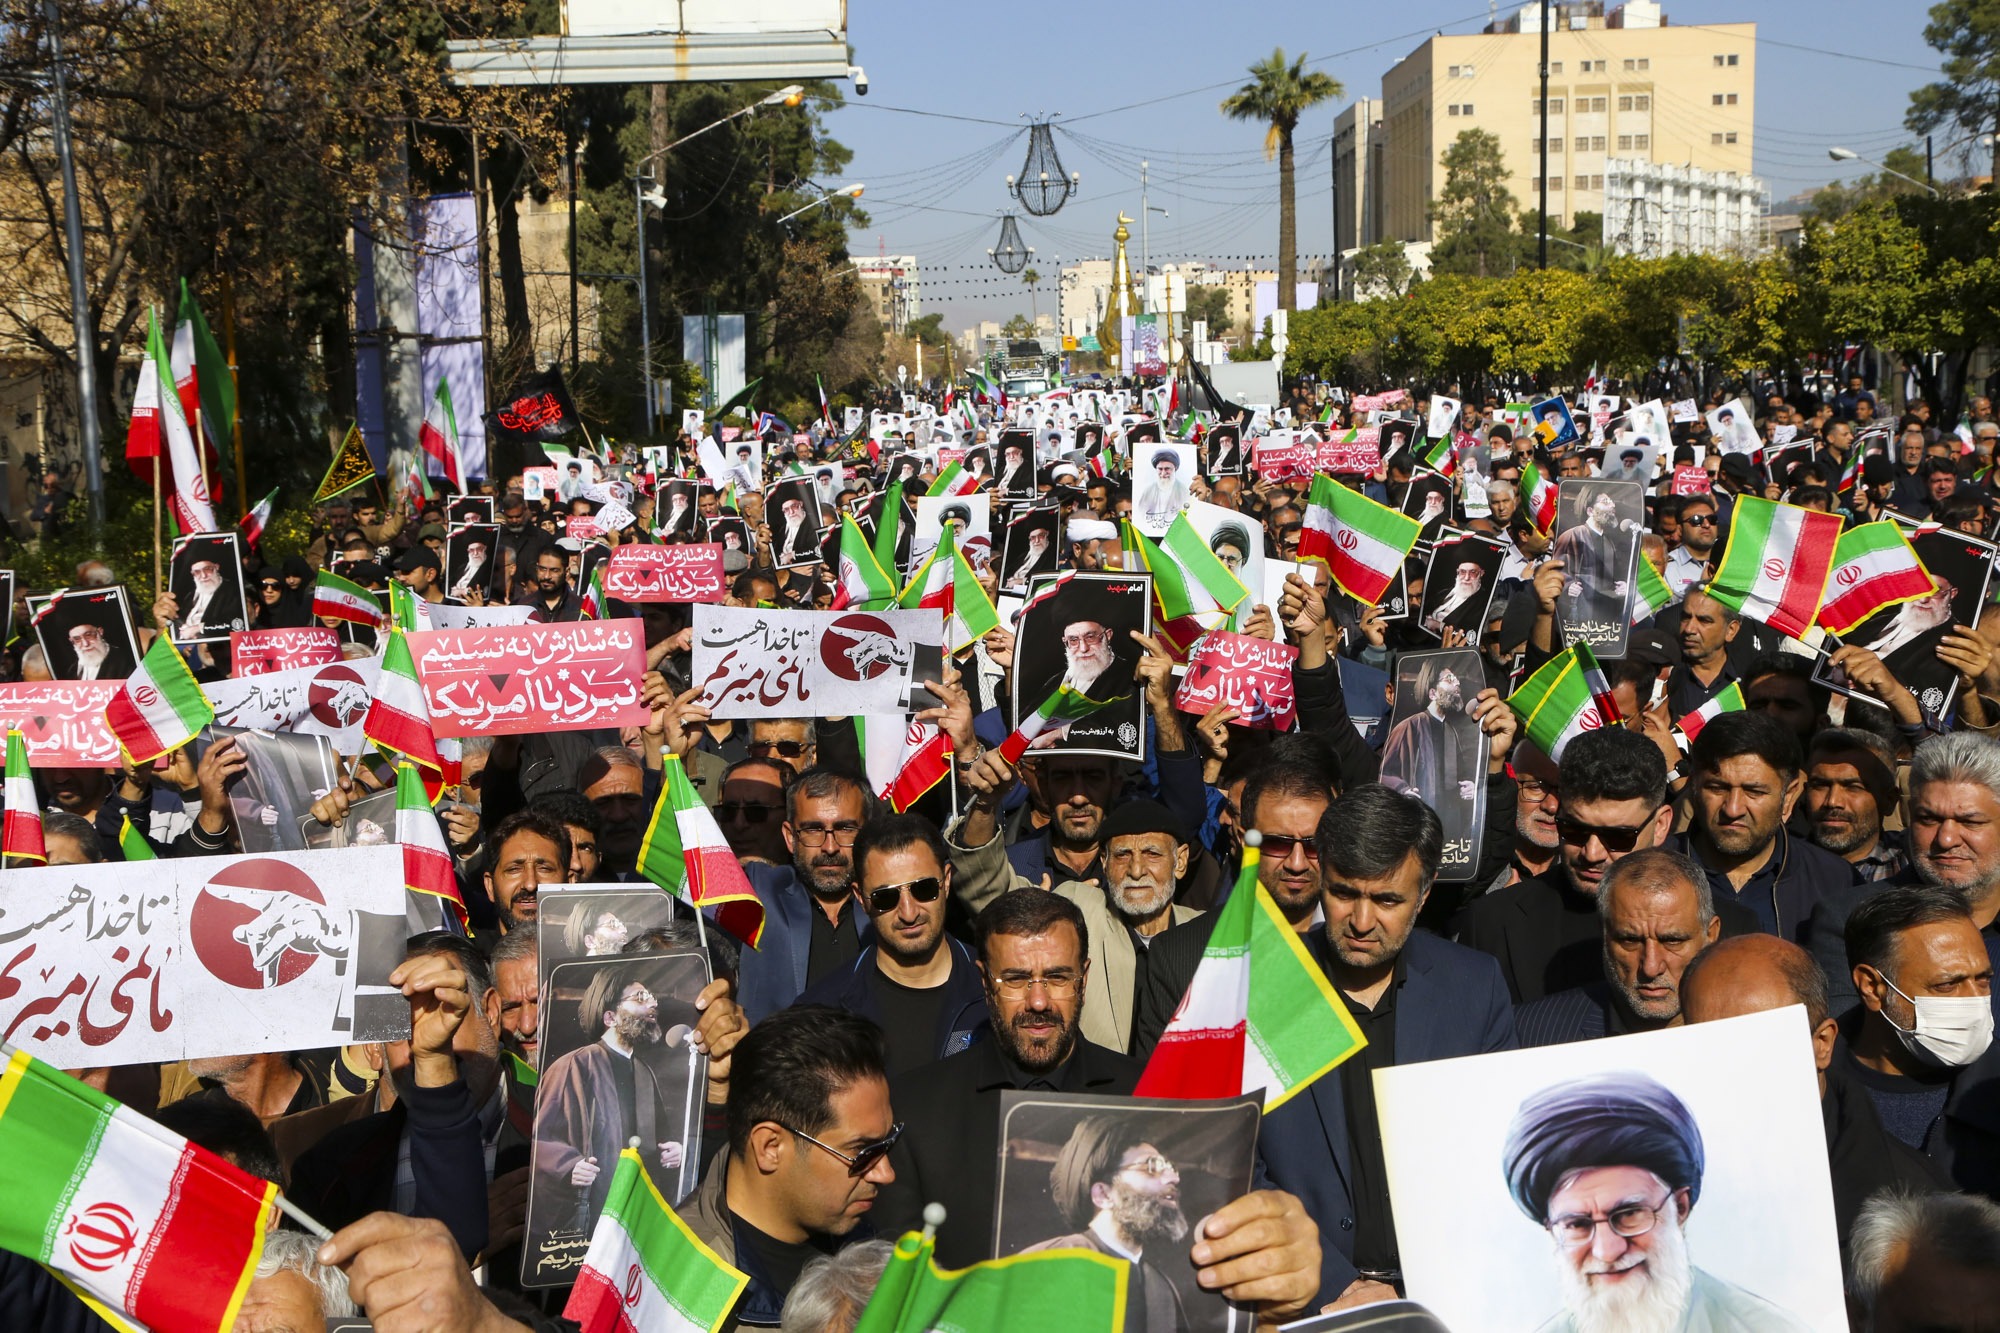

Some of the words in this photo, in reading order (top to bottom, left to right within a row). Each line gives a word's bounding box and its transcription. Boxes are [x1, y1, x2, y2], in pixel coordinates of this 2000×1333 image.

[1319, 454, 1353, 471] آمریکا
[610, 548, 650, 568] تسلیم
[649, 550, 663, 562] نه
[662, 547, 704, 568] سازش
[704, 549, 718, 561] نه
[606, 567, 667, 599] آمریکا
[664, 572, 681, 598] با
[680, 567, 720, 599] نبرد
[1107, 584, 1128, 592] شهید
[1127, 583, 1143, 594] امام
[701, 618, 768, 649] هست
[1563, 621, 1588, 633] هست
[1588, 620, 1612, 633] خدا
[1608, 630, 1620, 642] ما
[1612, 621, 1622, 633] تا
[236, 635, 271, 658] تسلیم
[270, 637, 286, 650] نه
[285, 632, 327, 653] سازش
[326, 633, 338, 647] نه
[505, 636, 532, 657] نه
[532, 626, 607, 664] سازش
[606, 629, 633, 651] نه
[763, 625, 791, 652] خدا
[792, 626, 810, 651] تا
[1215, 638, 1235, 658] نه
[1587, 632, 1608, 646] نمی
[420, 635, 506, 678] تسلیم
[1231, 643, 1287, 671] سازش
[759, 654, 800, 707] نمی
[797, 657, 811, 702] ما
[0, 685, 52, 709] تسلی
[51, 687, 74, 705] نه
[211, 684, 261, 719] هست
[260, 687, 279, 713] خدا
[283, 686, 298, 708] تا
[423, 666, 540, 730] آمریکا
[534, 674, 568, 722] با
[564, 663, 637, 724] نبرد
[1241, 680, 1294, 722] نبرد
[71, 719, 93, 760] با
[1070, 727, 1086, 736] رسید
[1085, 726, 1108, 736] آرزویش
[1460, 837, 1472, 852] تا
[1441, 852, 1455, 864] نم
[1455, 850, 1470, 864] ما
[0, 883, 92, 945] هست
[86, 893, 135, 942] خدا
[137, 892, 171, 935] تا
[77, 943, 151, 1047] نمی
[149, 945, 174, 1032] ما
[539, 1236, 592, 1253] ست
[536, 1252, 586, 1276] یریم
